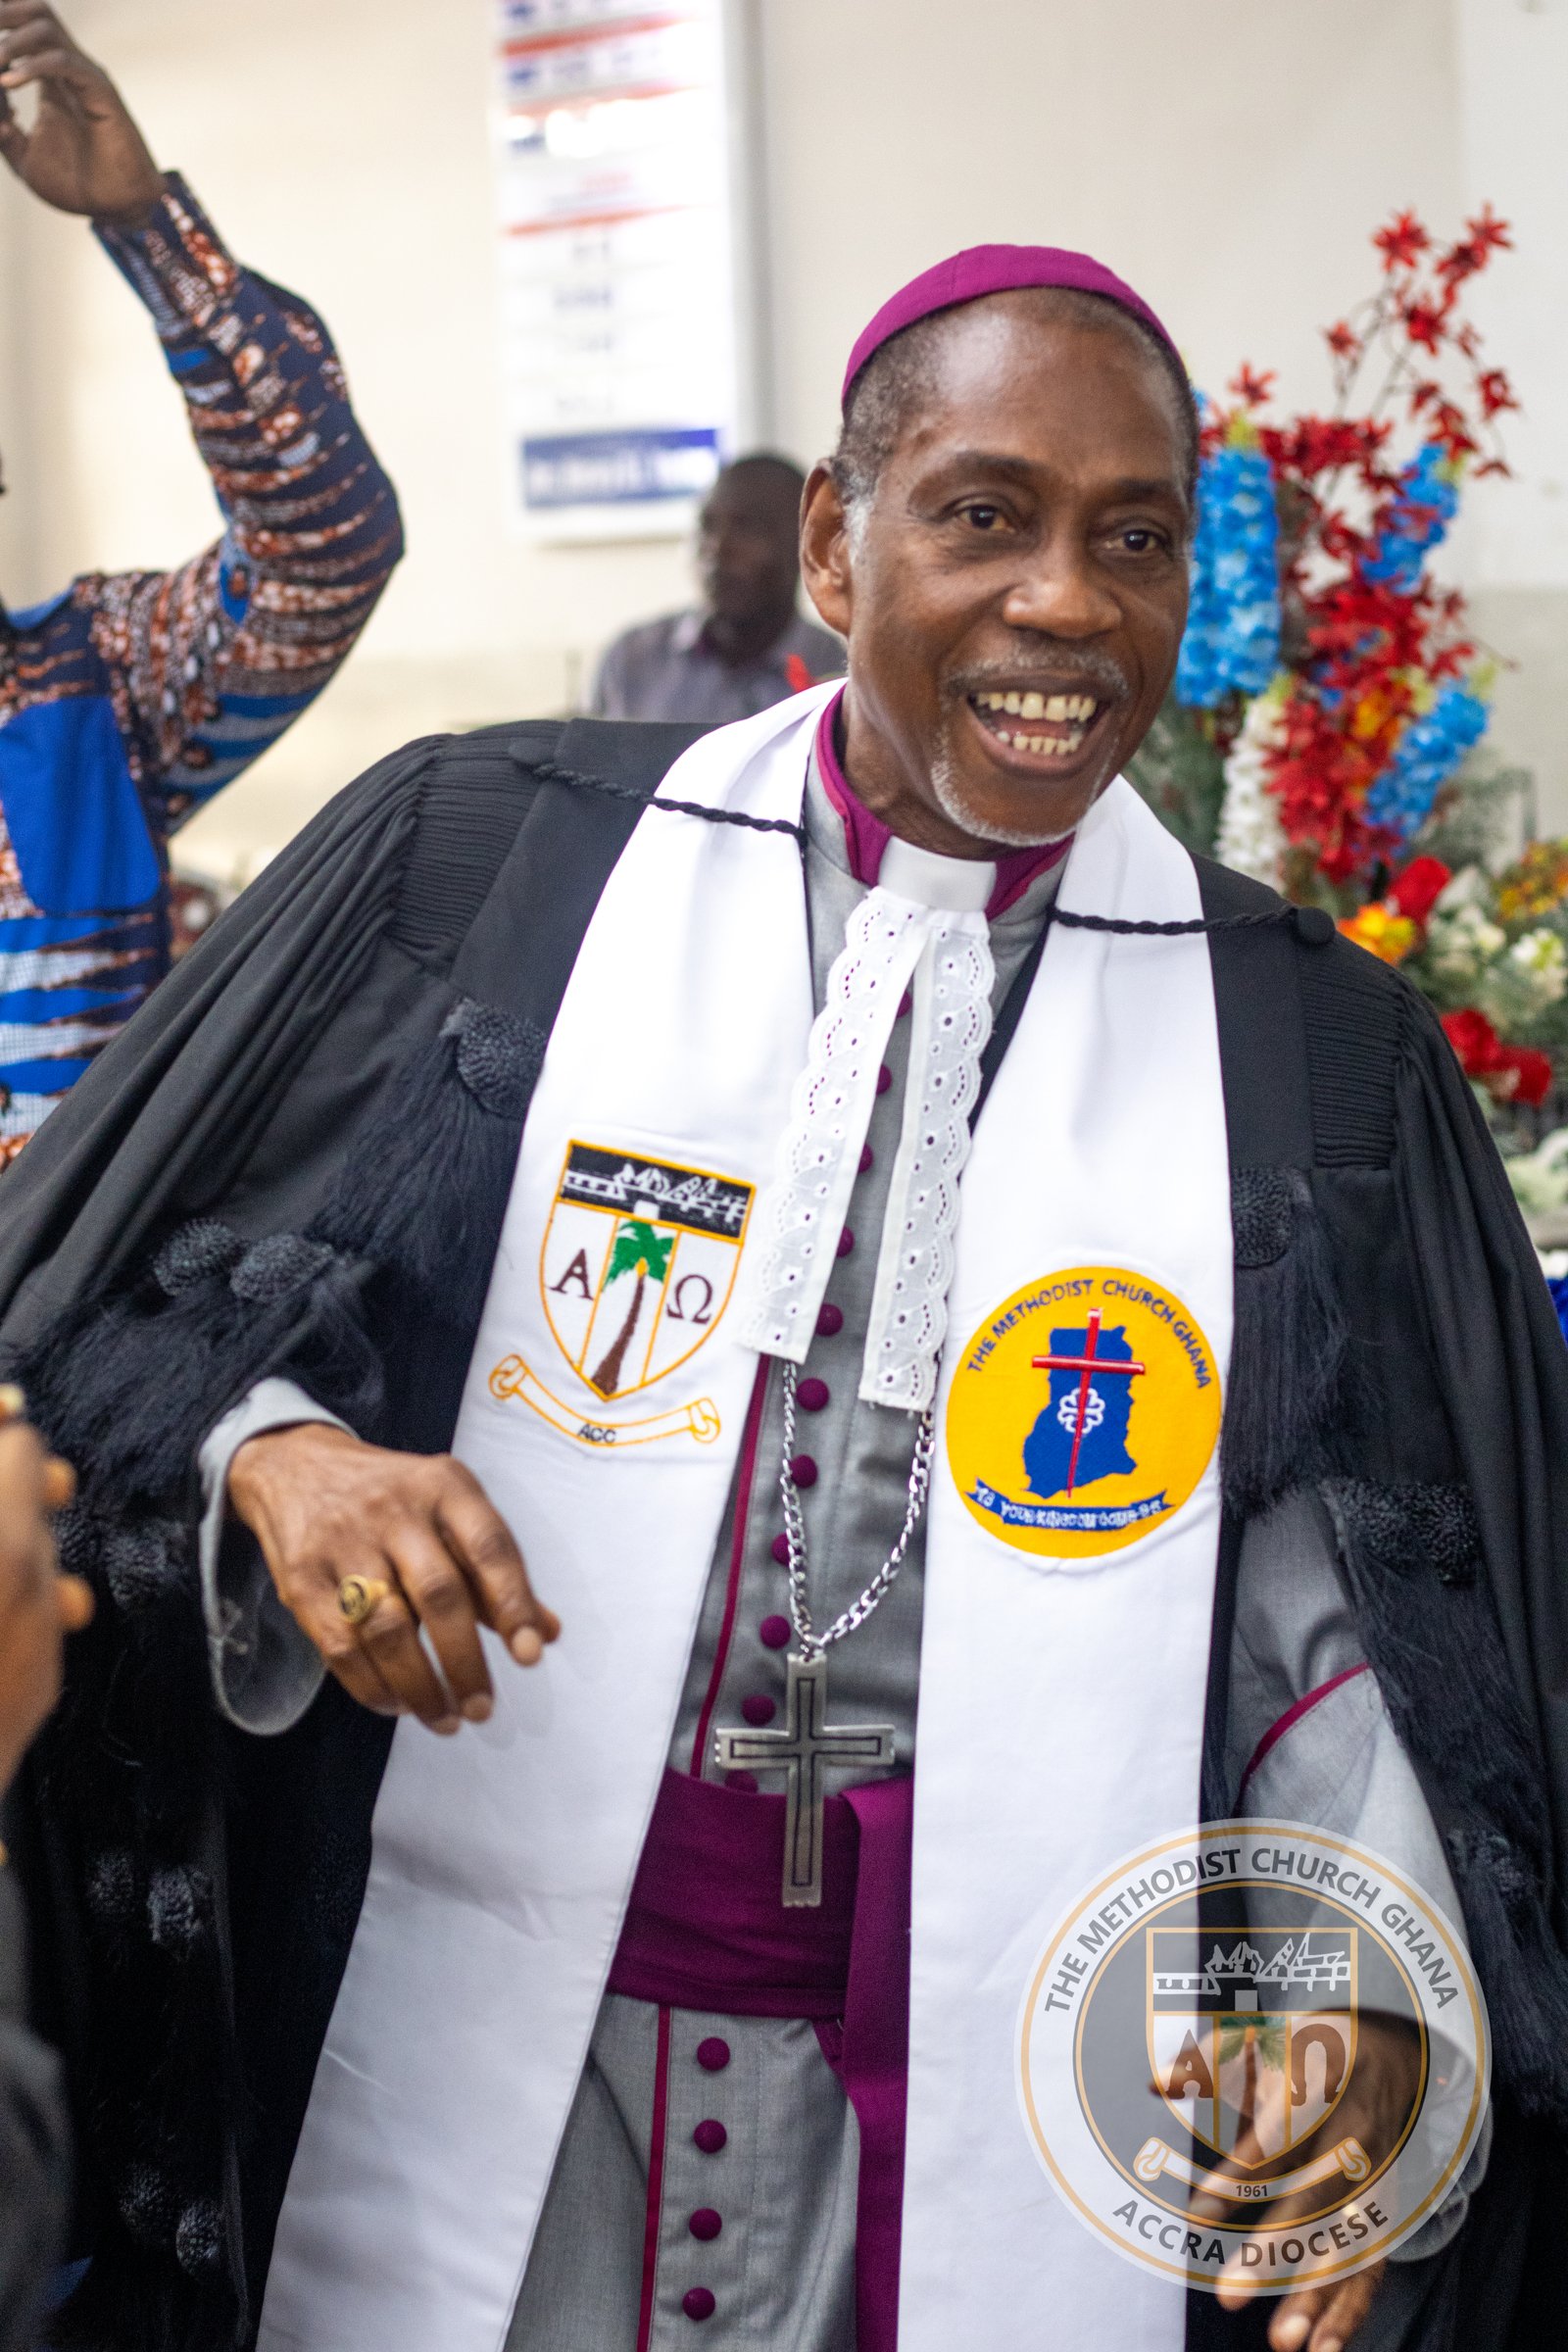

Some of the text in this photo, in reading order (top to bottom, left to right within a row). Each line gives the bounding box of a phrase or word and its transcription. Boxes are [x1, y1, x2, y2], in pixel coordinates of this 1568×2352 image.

[548, 1248, 713, 1325] A Ω
[966, 1279, 1211, 1389] THE METHODIST CHURCH GHANA
[578, 1423, 616, 1444] ACC
